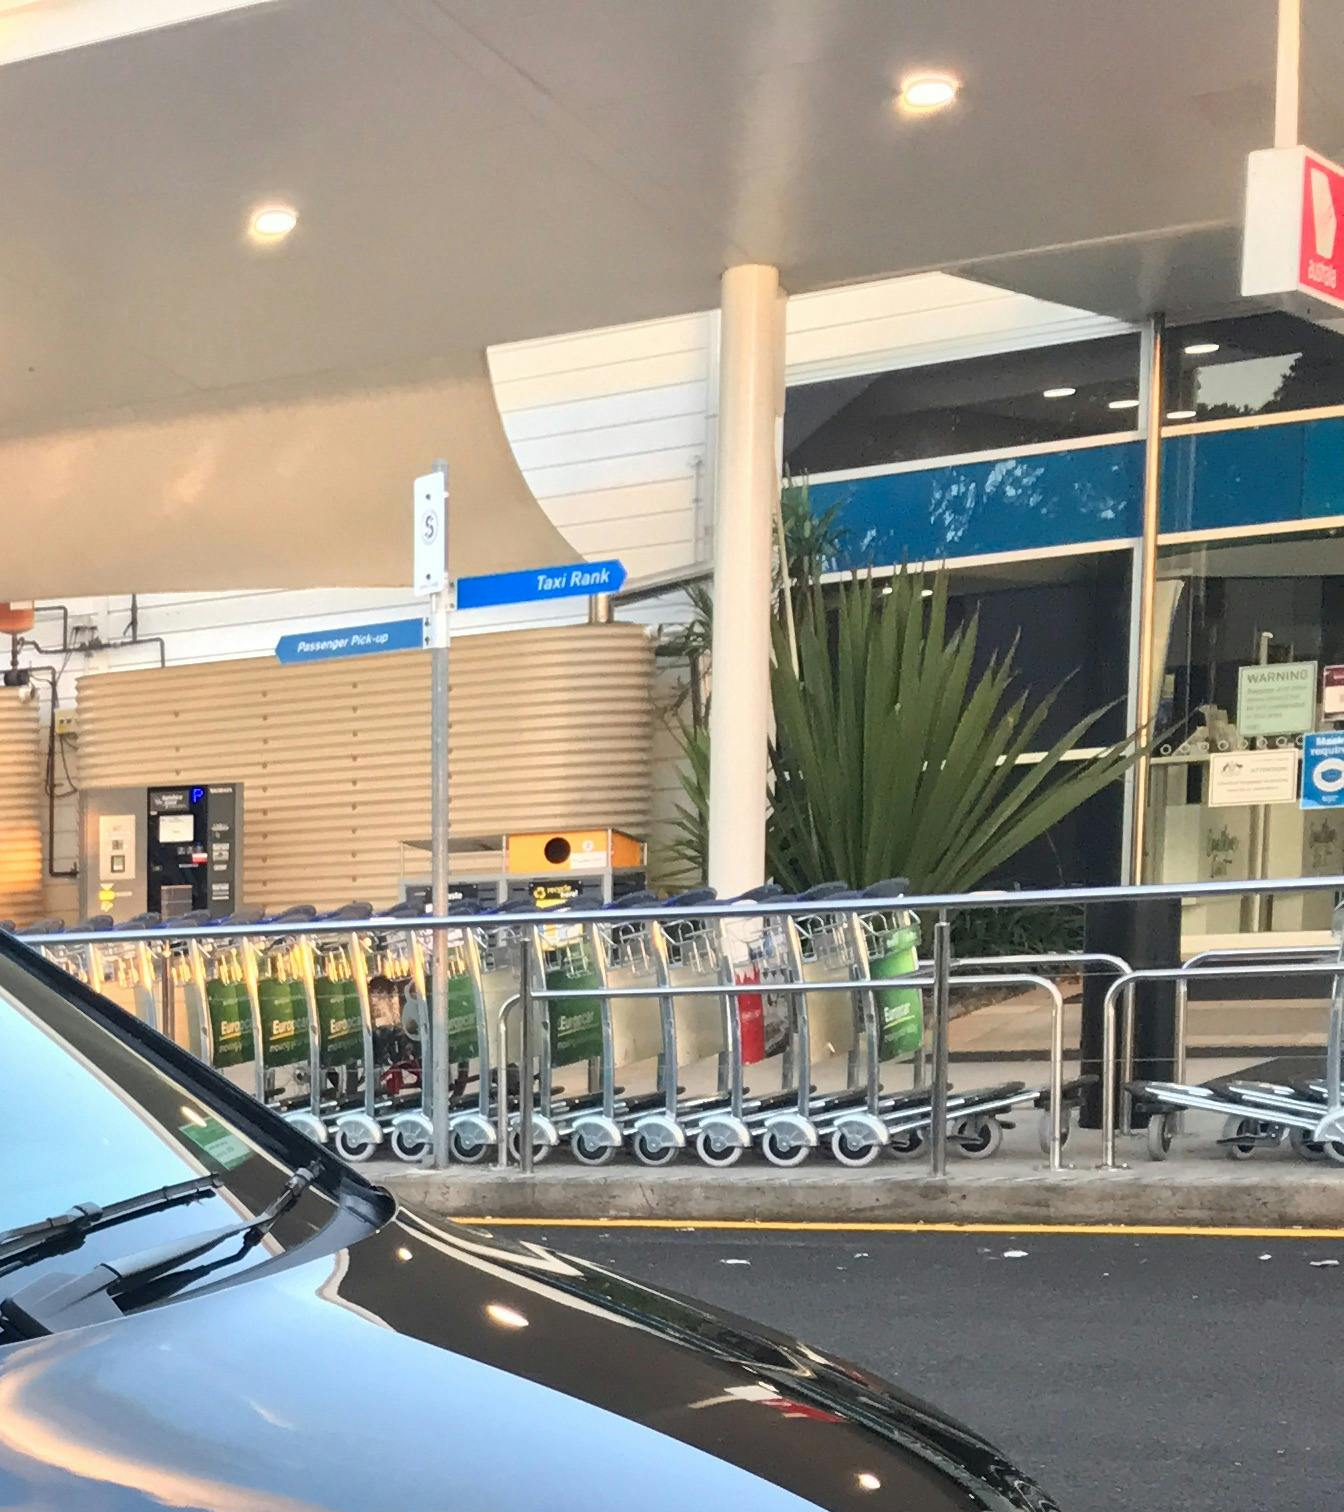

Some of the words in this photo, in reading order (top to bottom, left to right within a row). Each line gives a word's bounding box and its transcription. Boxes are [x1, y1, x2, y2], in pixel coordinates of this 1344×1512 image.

[537, 574, 567, 590] Taxi
[570, 568, 610, 587] Rank
[297, 638, 348, 653] Passenger
[351, 633, 389, 645] Pick-up
[1247, 668, 1309, 683] WARNING
